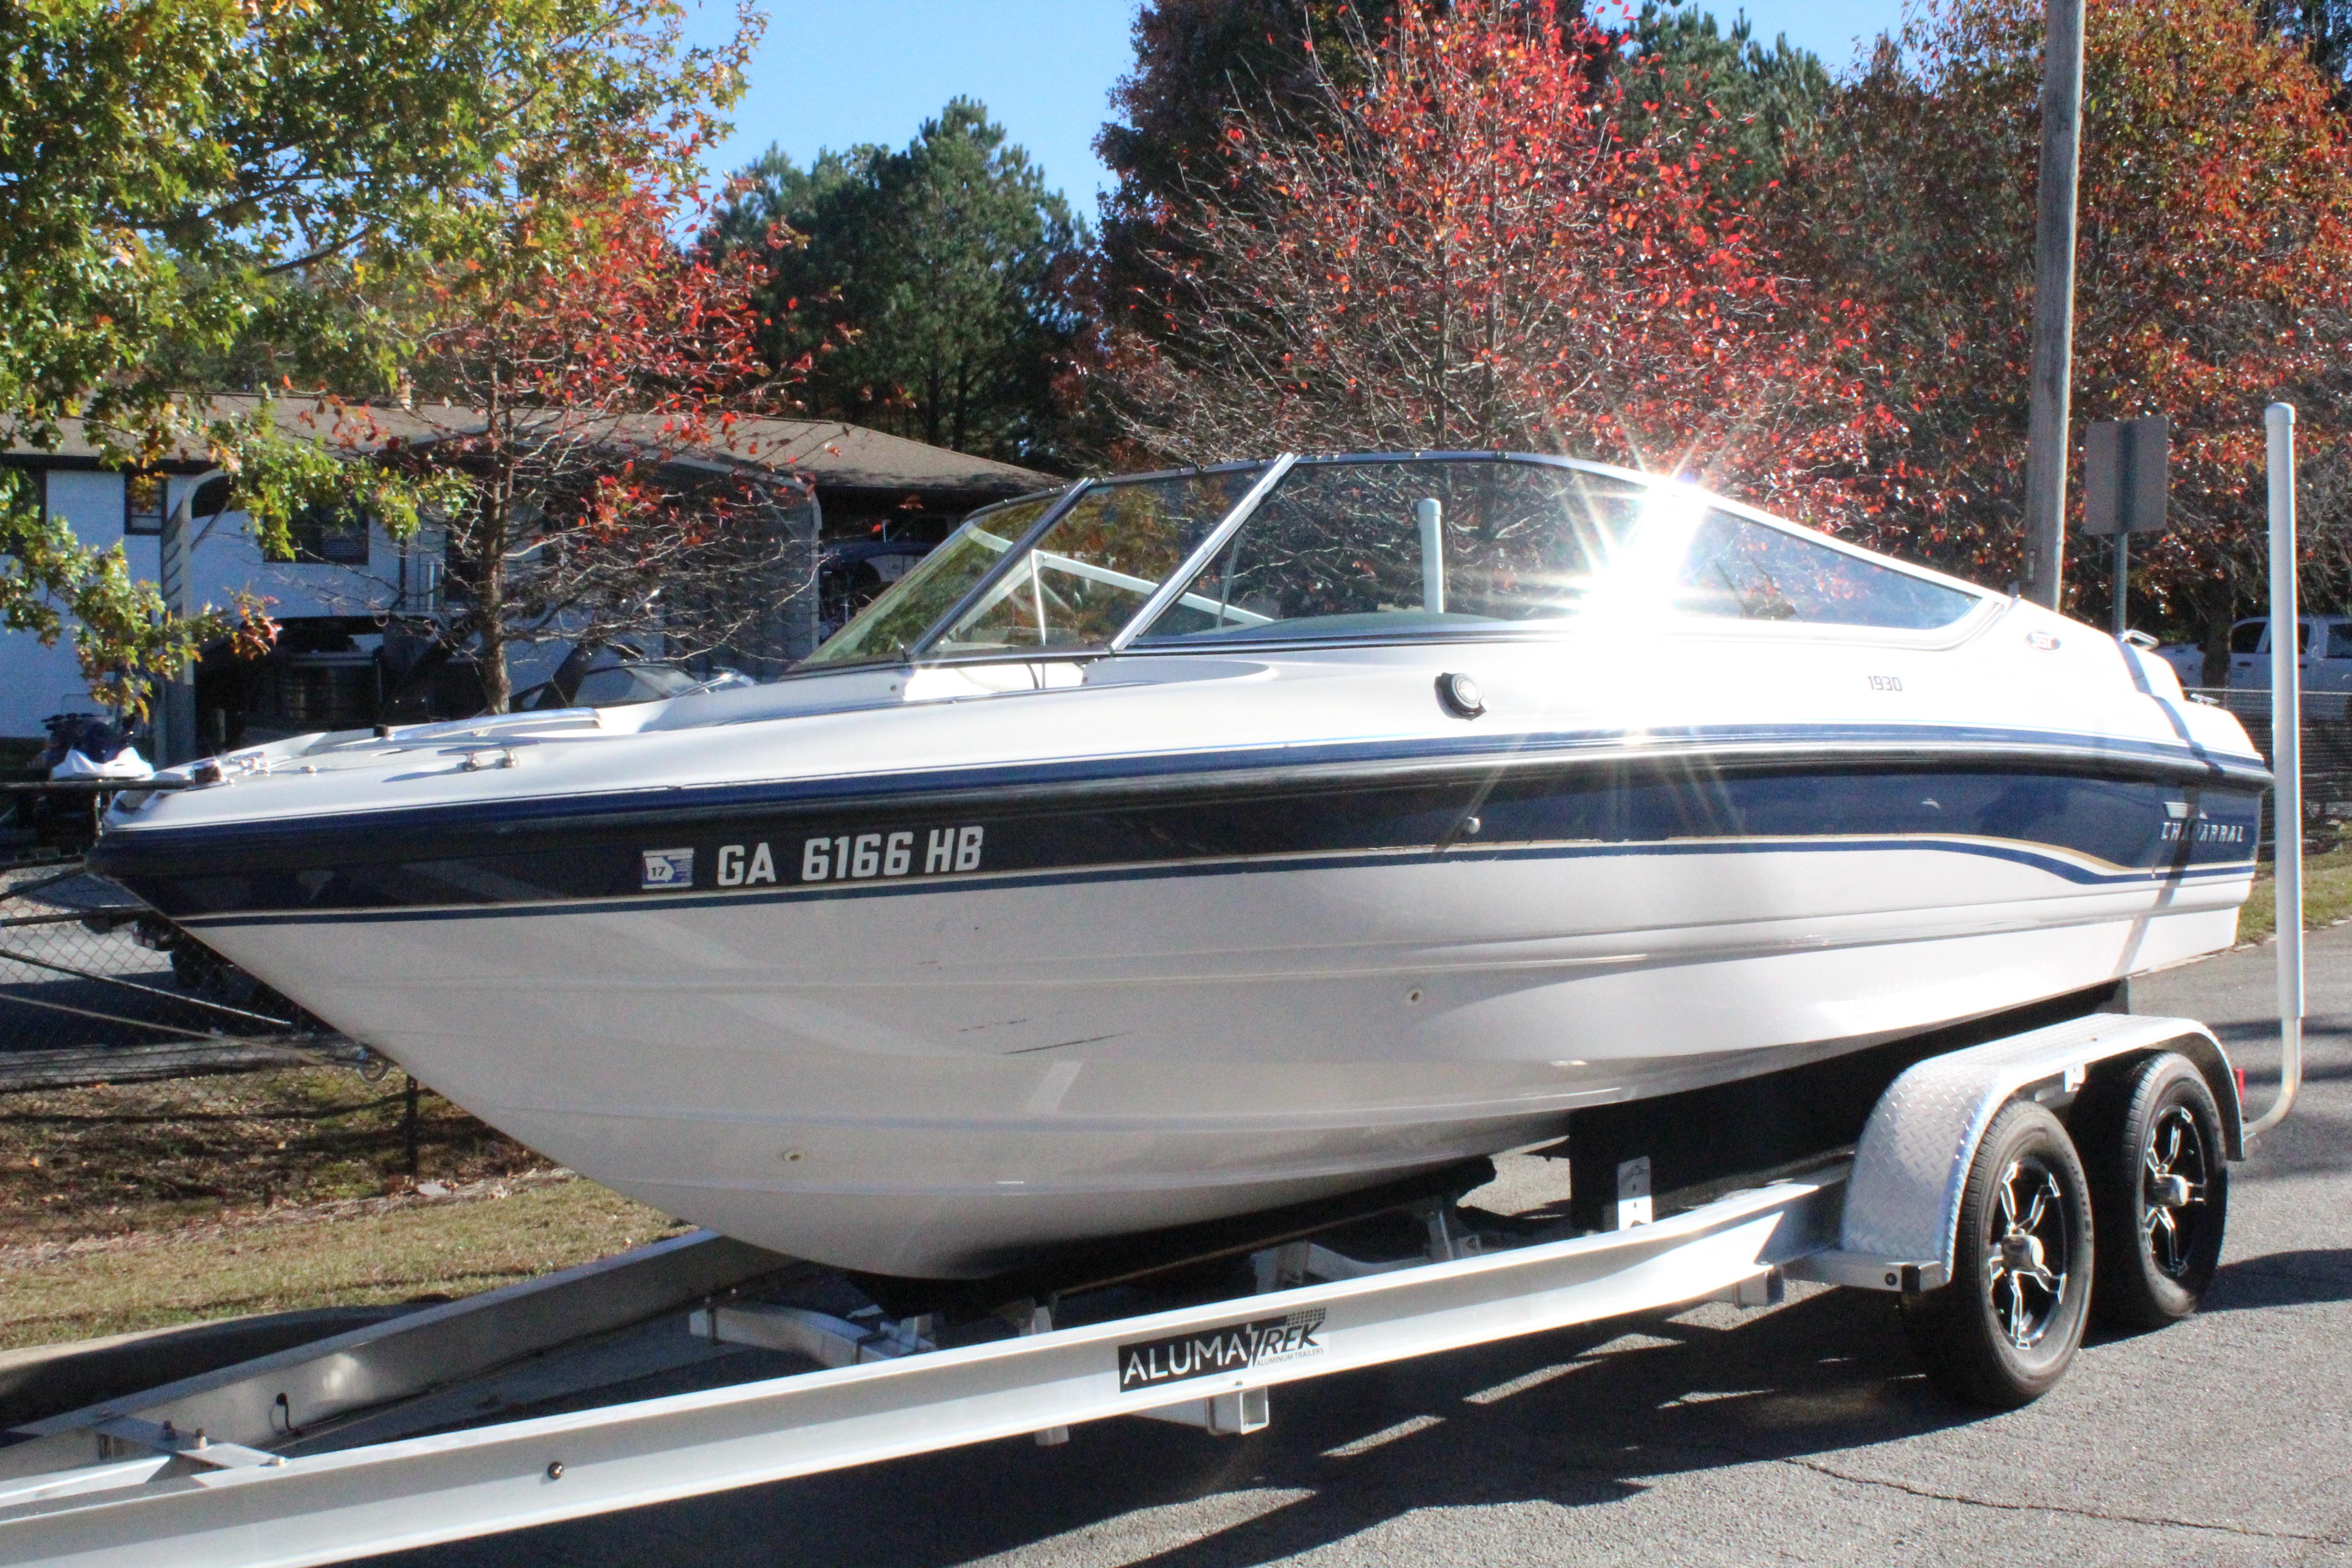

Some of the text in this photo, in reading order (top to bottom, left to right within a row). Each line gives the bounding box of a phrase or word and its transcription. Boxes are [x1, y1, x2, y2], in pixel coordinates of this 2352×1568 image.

[1867, 676, 1902, 691] 1930
[2160, 822, 2244, 843] CHARRAL
[716, 842, 776, 886] GA
[802, 831, 913, 881] 6166
[925, 826, 984, 873] HB
[651, 866, 666, 877] 17
[1256, 1348, 1324, 1367] ALUMINUM TRAILERS
